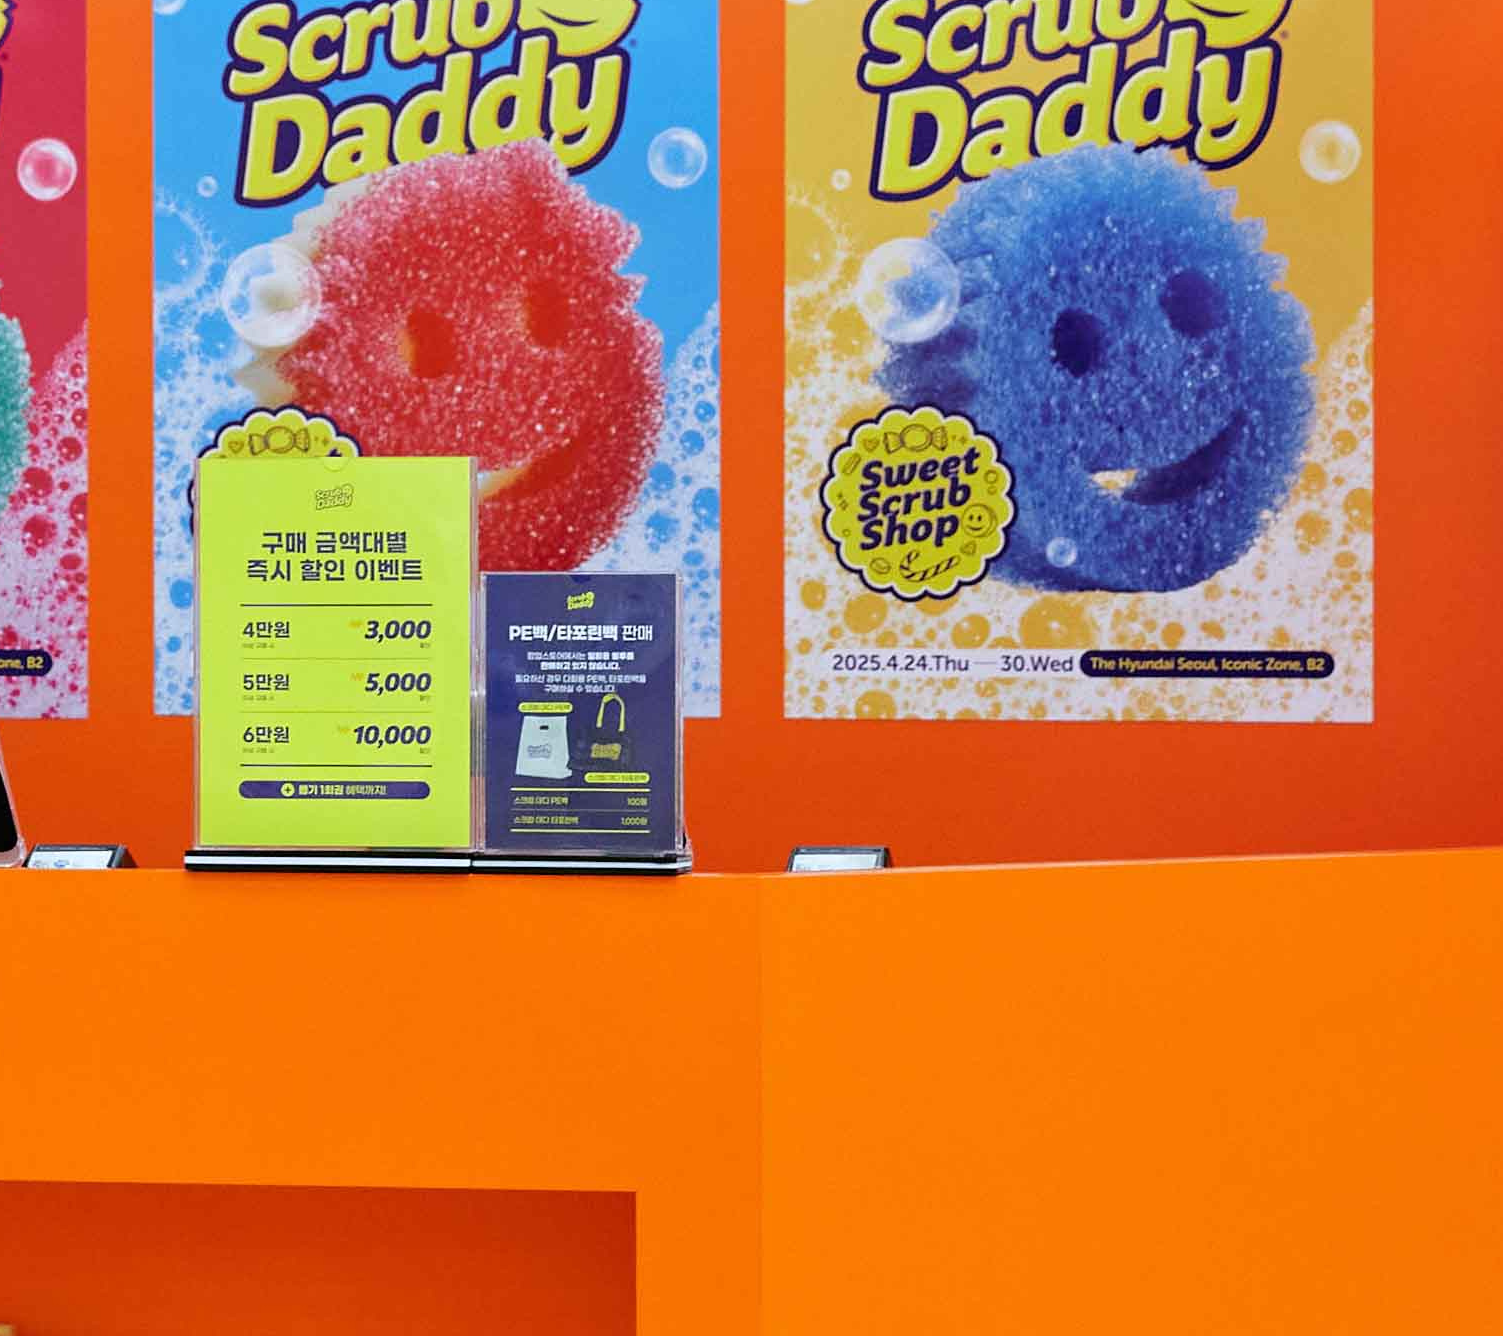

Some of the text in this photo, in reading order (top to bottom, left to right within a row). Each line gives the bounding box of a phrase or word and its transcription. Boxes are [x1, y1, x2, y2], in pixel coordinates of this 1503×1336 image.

[240, 33, 626, 202] Daddy
[875, 26, 1277, 197] Daddy
[859, 447, 980, 493] Sweet
[857, 476, 972, 522] Scrub
[261, 531, 408, 554] 구매 금액대별
[859, 511, 961, 551] Shop
[246, 559, 424, 582] 즉시 할인 이벤트
[242, 620, 291, 639] 4만원
[363, 619, 432, 643] 3,000
[508, 624, 653, 642] PE백/타포린백 판매
[26, 655, 44, 669] B2
[832, 654, 970, 672] 2025.4.24.Thu
[1000, 654, 1074, 673] 30.Wed
[1090, 656, 1325, 673] The Hyundai Seoul, Iconic Zone, B2
[242, 673, 291, 691] 5만원
[364, 672, 432, 696] 5,000
[242, 726, 291, 744] 6만원
[353, 724, 432, 749] 10,000
